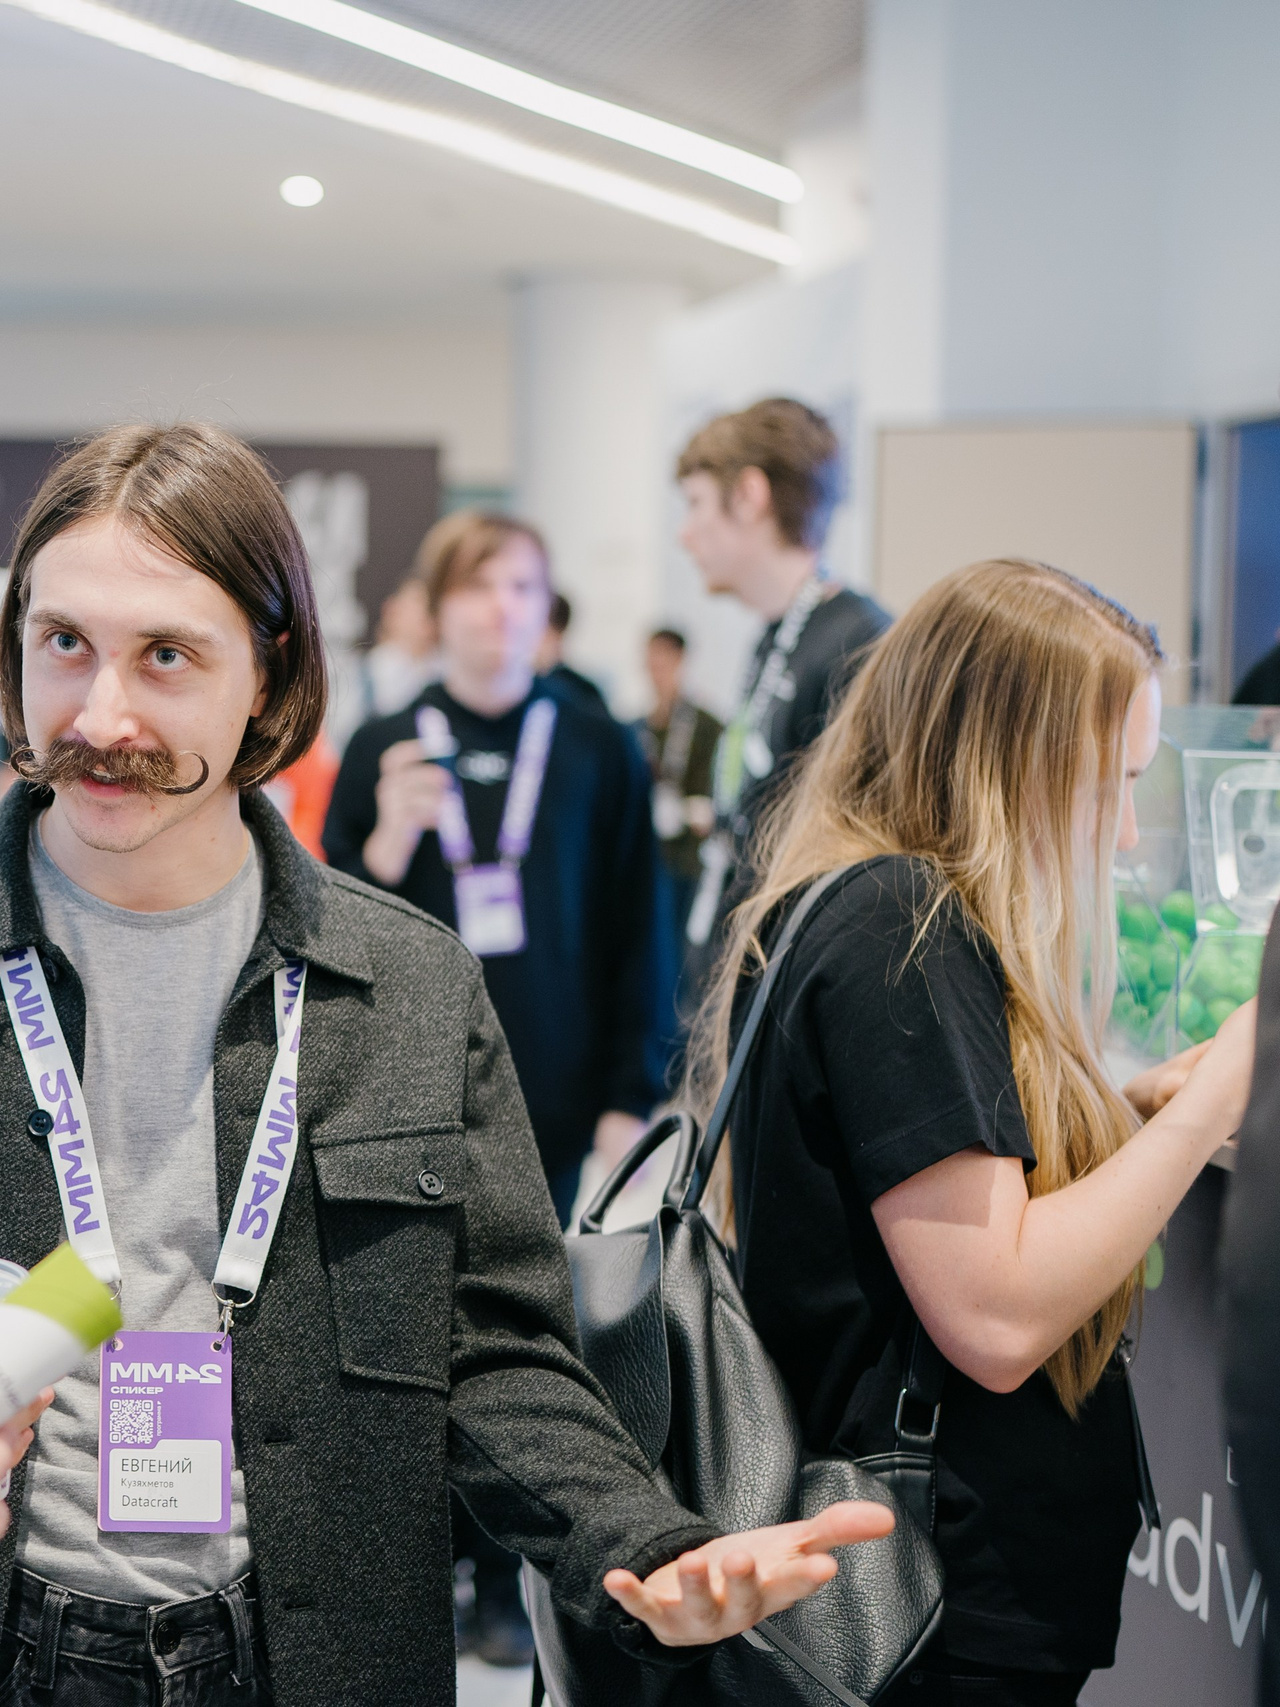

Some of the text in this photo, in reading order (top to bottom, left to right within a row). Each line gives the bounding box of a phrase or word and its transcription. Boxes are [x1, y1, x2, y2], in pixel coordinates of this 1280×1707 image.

[110, 1386, 164, 1395] СПИКЕР
[121, 1458, 193, 1474] ЕВГЕНИЙ
[120, 1478, 174, 1489] Кузяхметов
[121, 1494, 179, 1509] Datacraft
